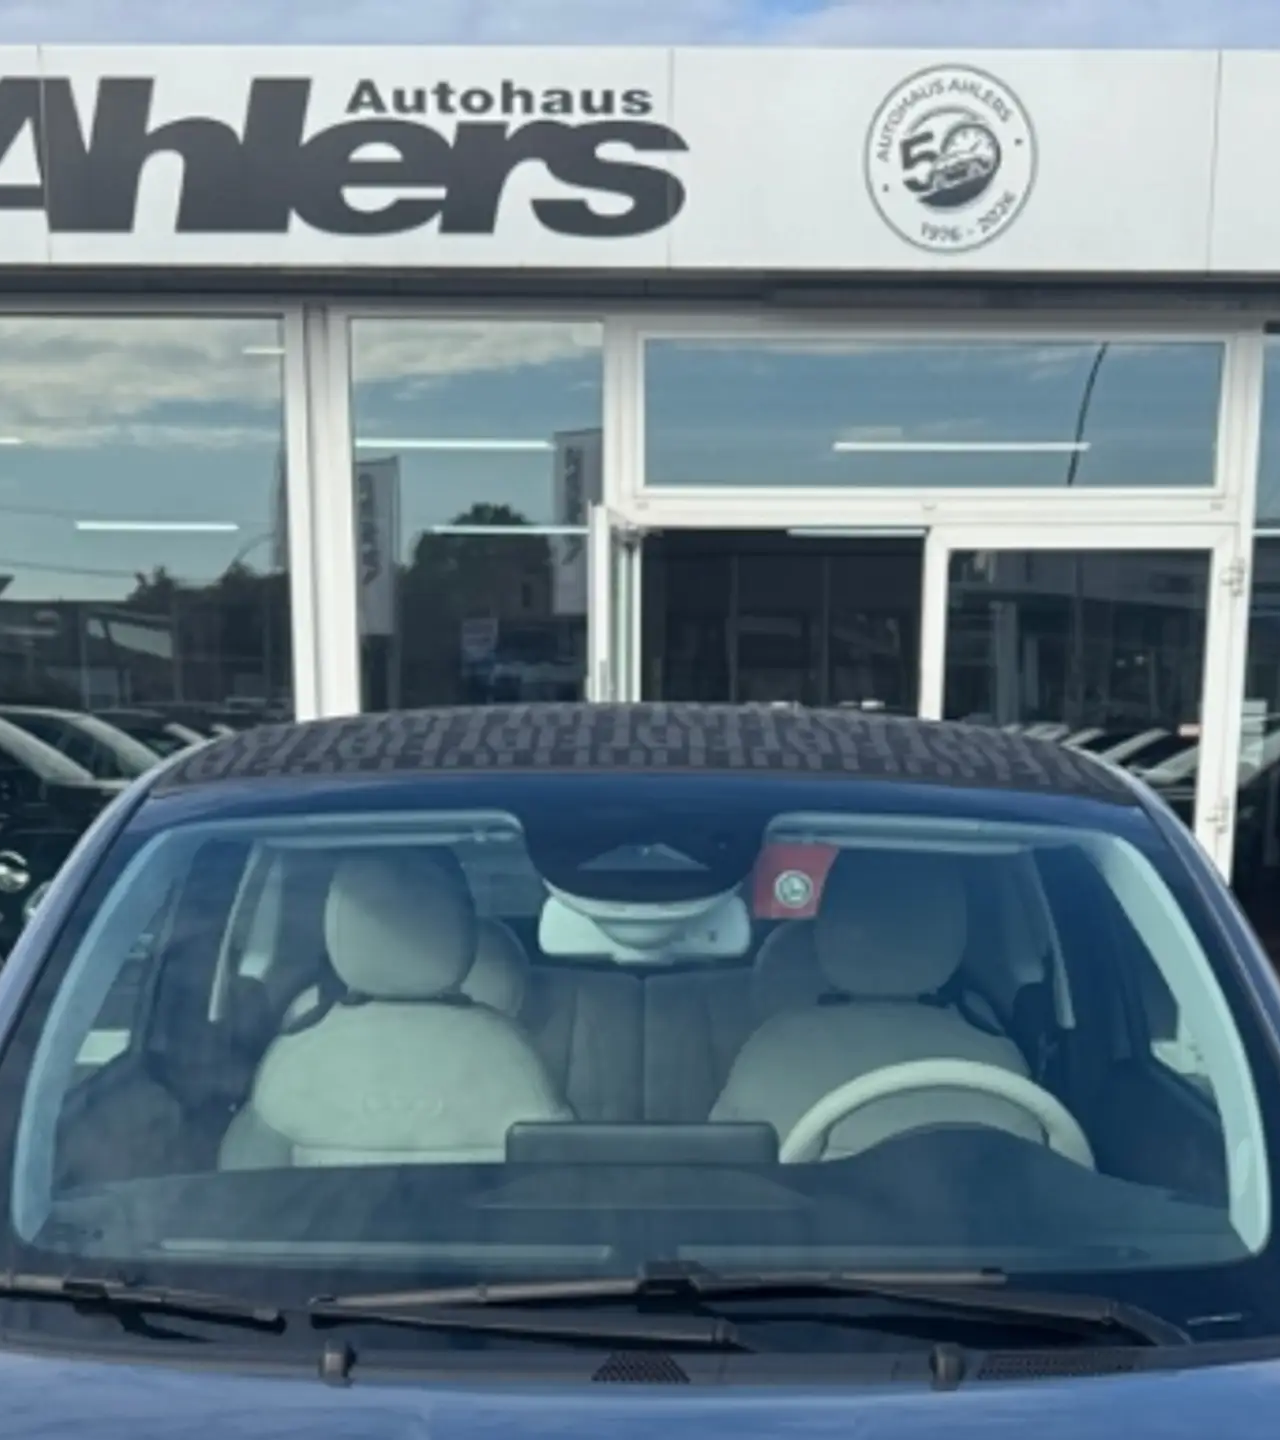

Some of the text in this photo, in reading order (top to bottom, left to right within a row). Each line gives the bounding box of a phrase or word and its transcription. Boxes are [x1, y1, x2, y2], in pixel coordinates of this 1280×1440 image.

[346, 78, 652, 115] Autohaus
[876, 77, 1014, 163] AUTOHAUS AHLERS
